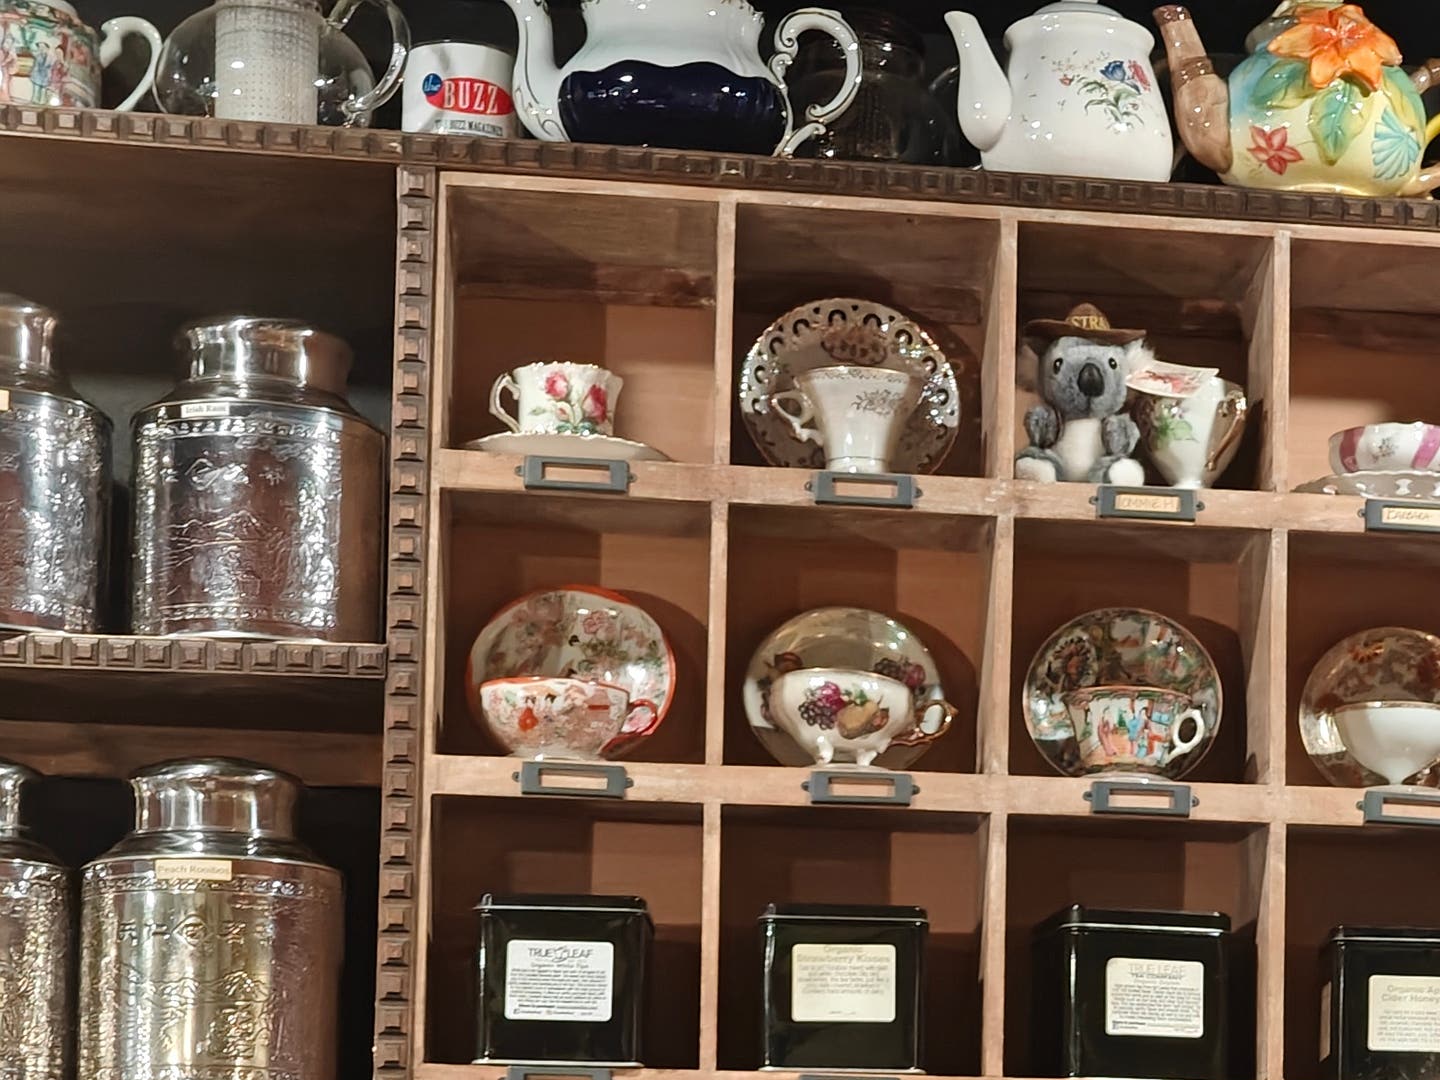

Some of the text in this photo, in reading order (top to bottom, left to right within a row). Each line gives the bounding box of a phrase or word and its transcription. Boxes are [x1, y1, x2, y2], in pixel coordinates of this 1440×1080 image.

[444, 80, 499, 114] BUZZ
[528, 947, 594, 959] TRUE LEAF
